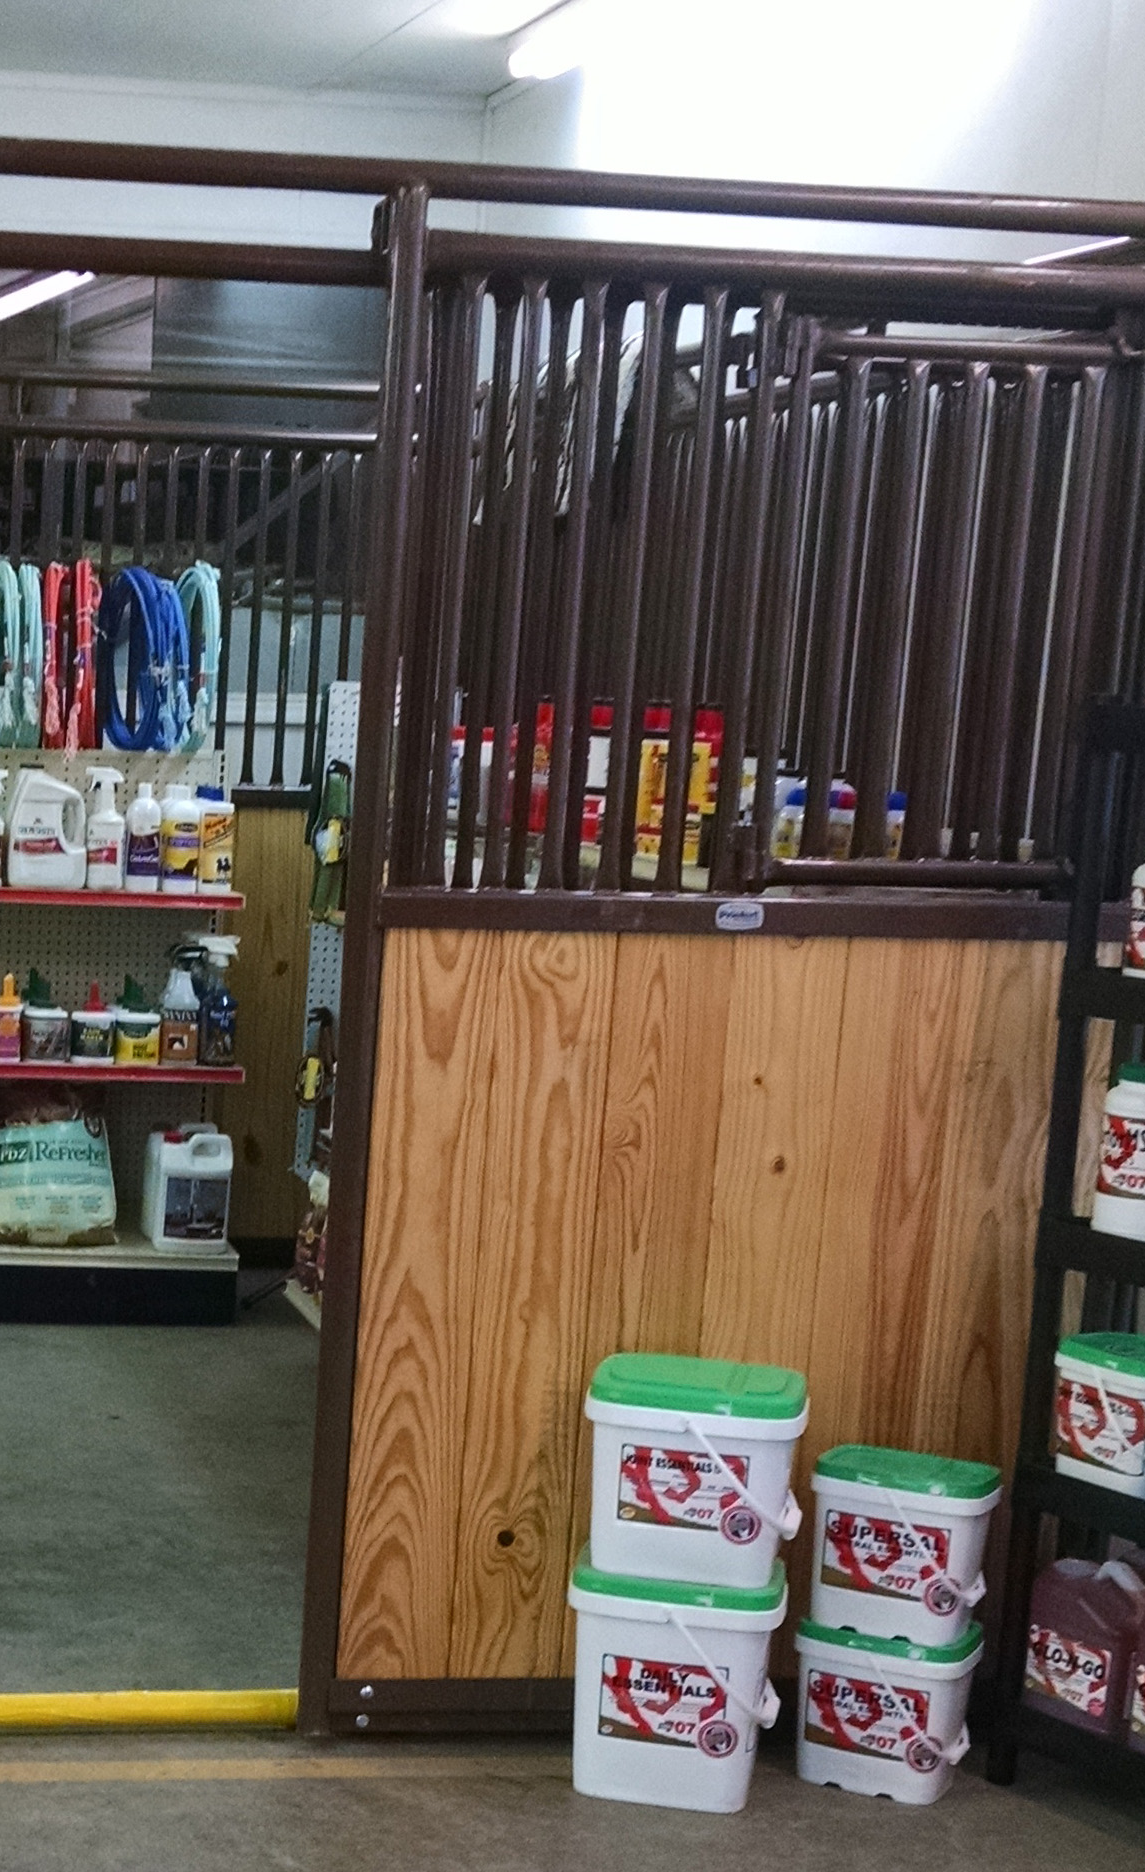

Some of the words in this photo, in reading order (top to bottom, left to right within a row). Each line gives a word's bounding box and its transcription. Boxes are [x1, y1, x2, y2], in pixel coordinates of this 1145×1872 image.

[656, 1457, 713, 1474] ESSENTIALS
[640, 1667, 690, 1684] DAILY
[612, 1675, 718, 1698] ESSENTIALS
